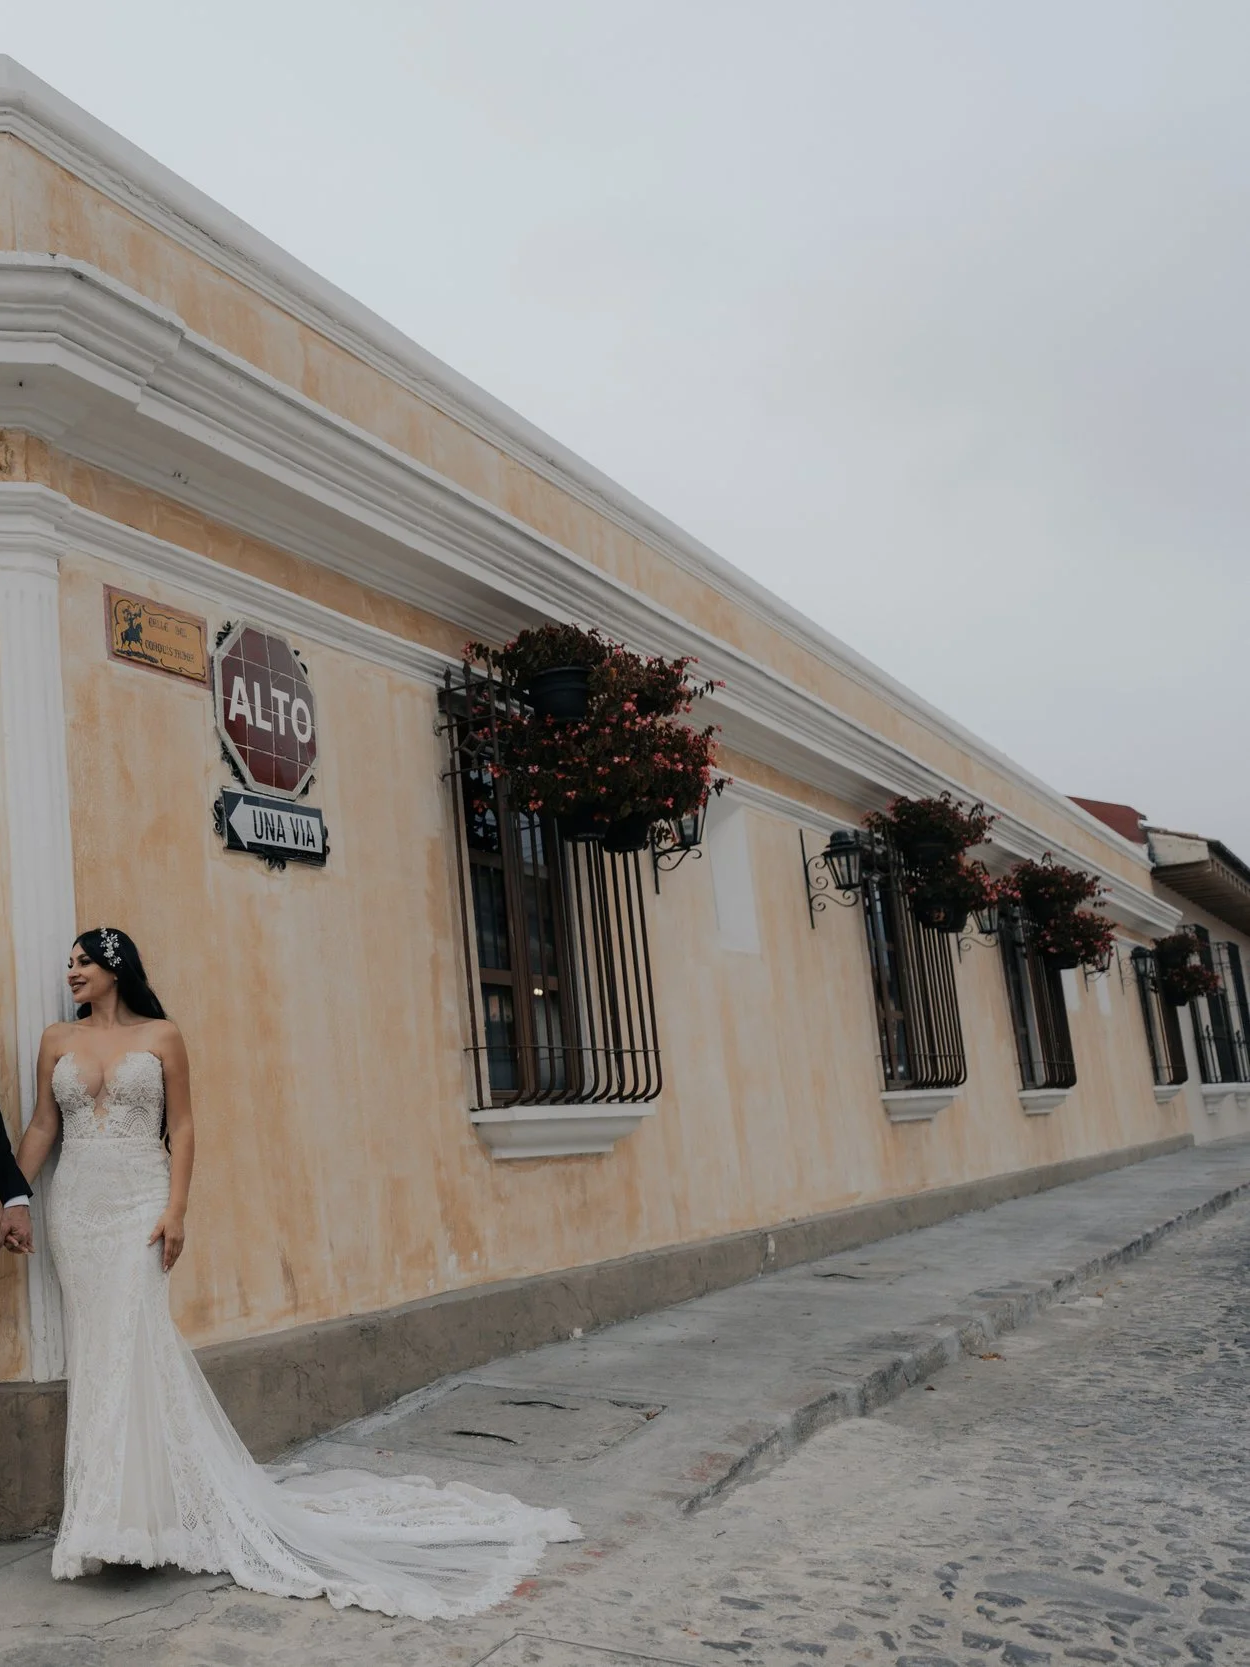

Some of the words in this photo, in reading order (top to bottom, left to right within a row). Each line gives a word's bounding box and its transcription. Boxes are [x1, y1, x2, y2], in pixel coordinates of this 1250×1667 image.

[228, 675, 312, 744] ALTO
[252, 809, 286, 843] UNA
[289, 816, 316, 848] VIA
